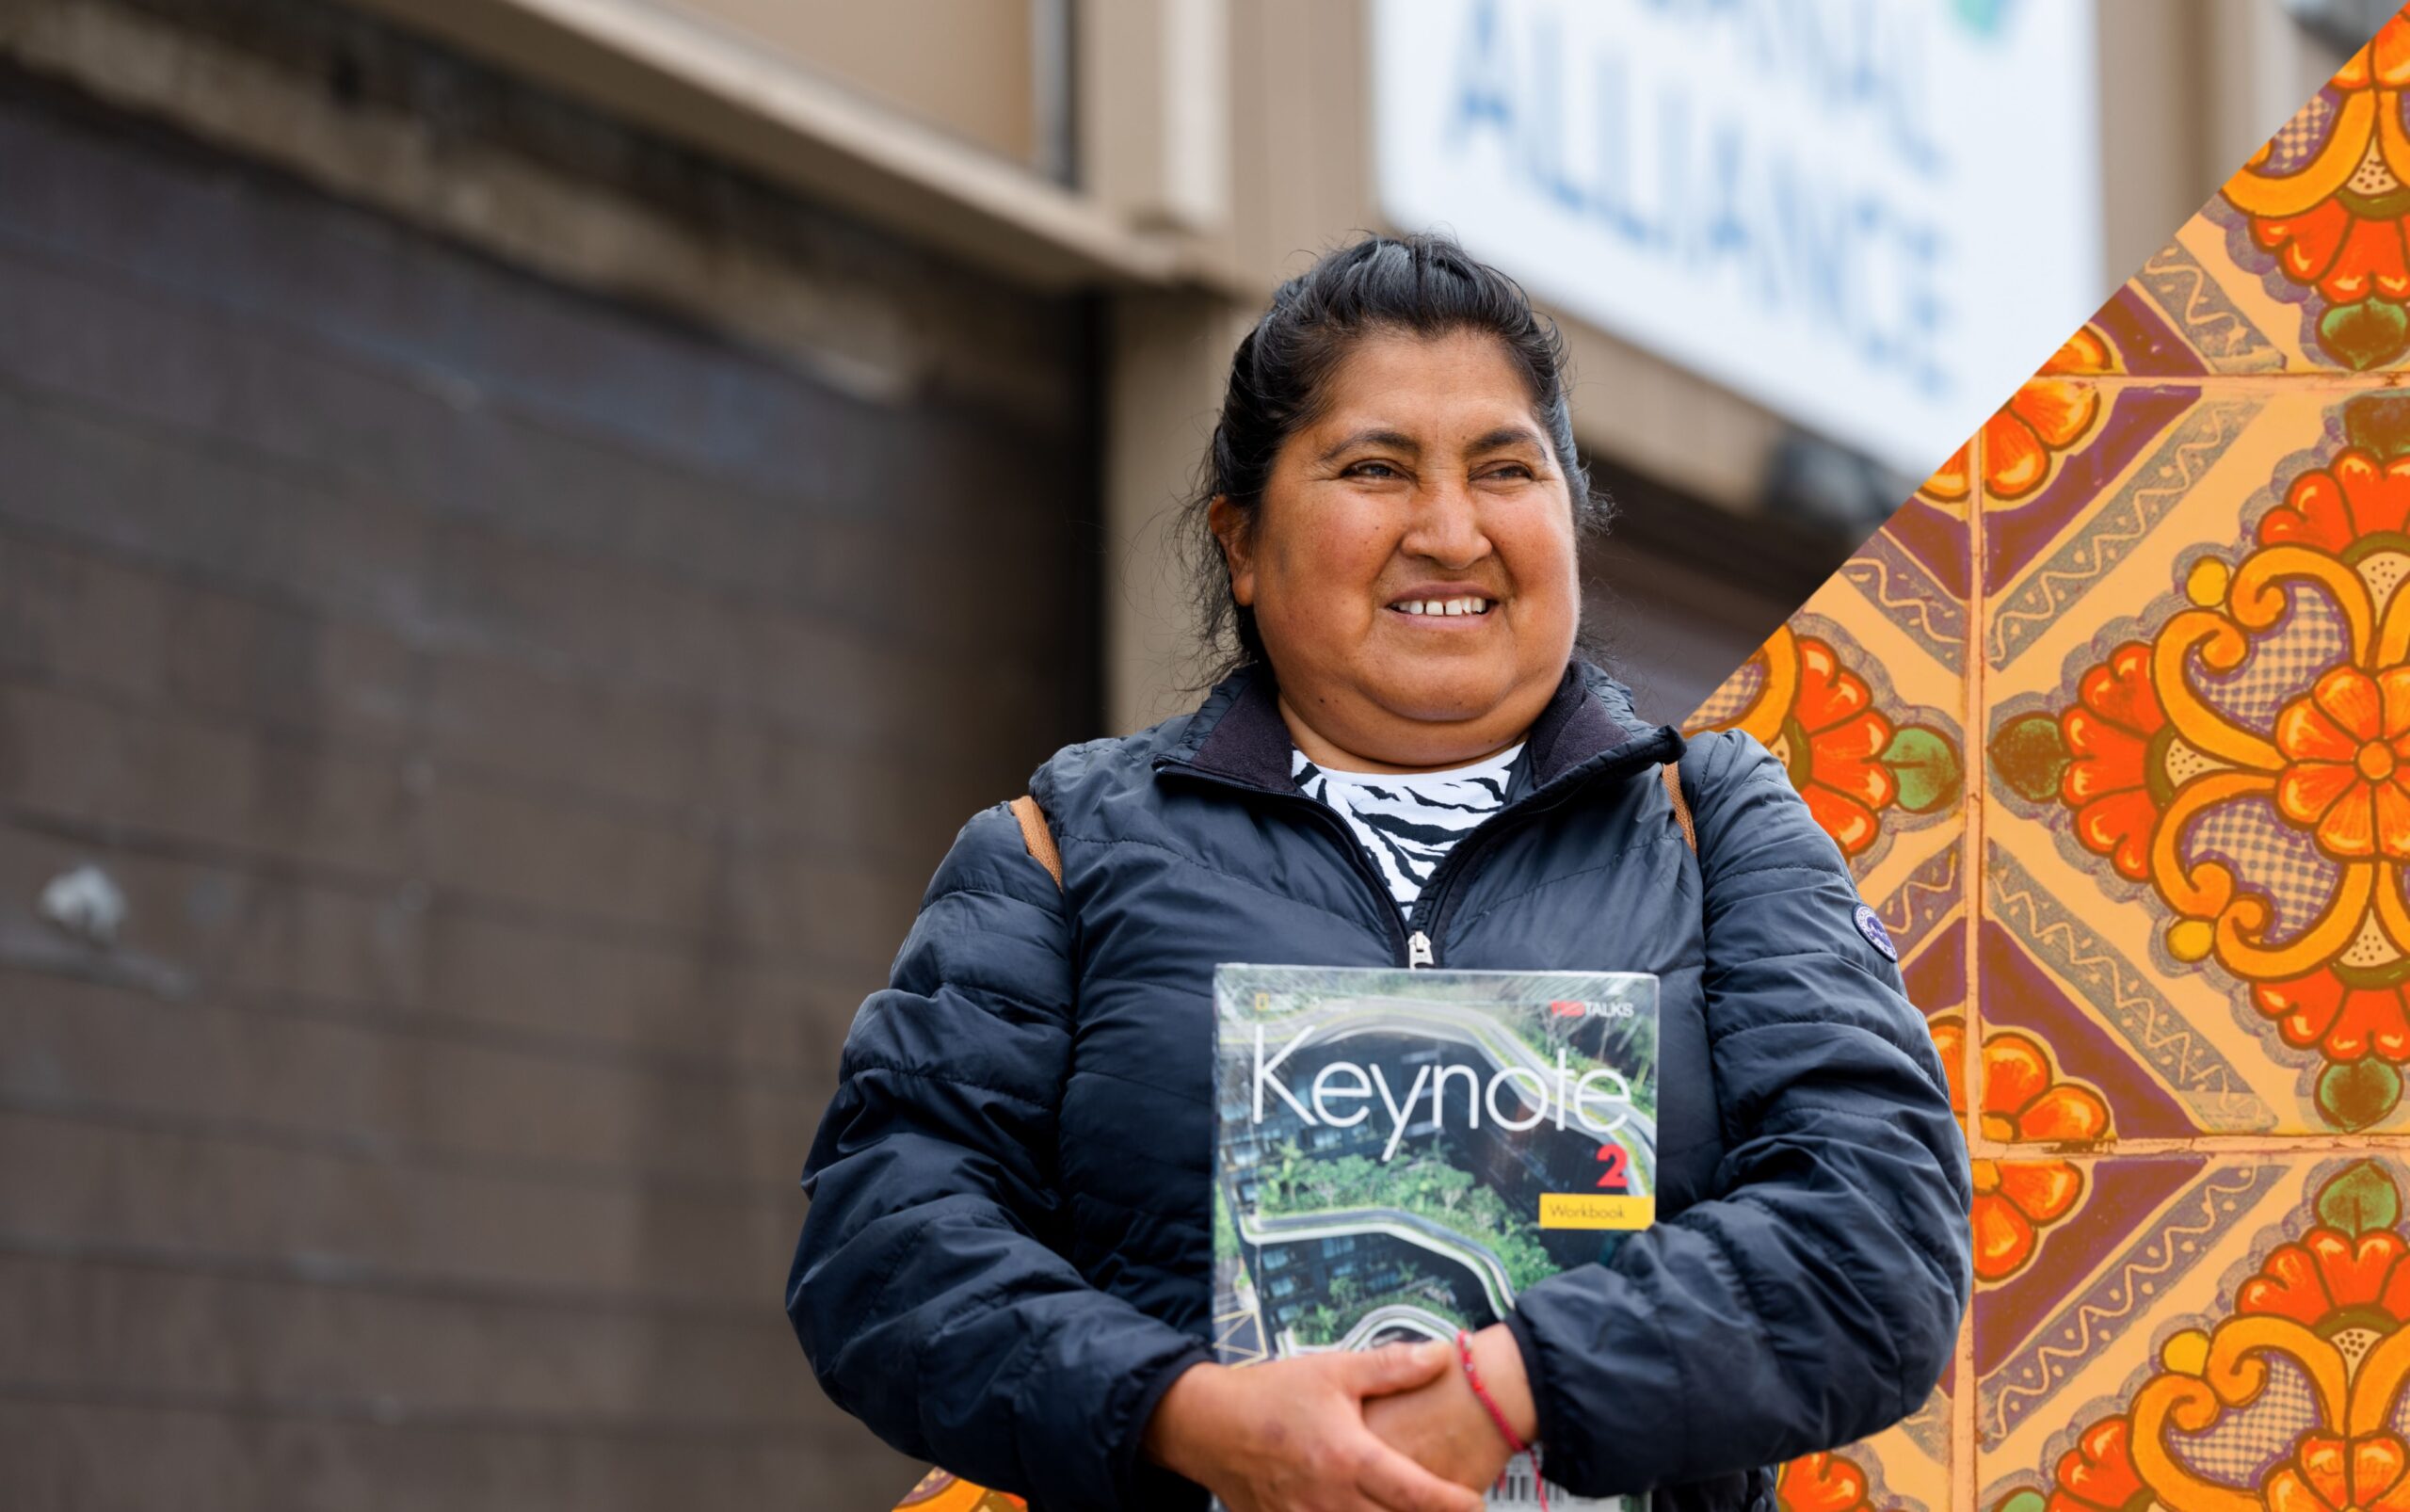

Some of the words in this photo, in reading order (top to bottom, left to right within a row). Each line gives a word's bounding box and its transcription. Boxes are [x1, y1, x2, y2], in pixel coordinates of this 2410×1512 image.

[1440, 0, 1956, 401] ALLIANCE
[1252, 1023, 1632, 1163] Keynote
[1549, 1203, 1626, 1219] Workbook
[1596, 1143, 1629, 1188] 2
